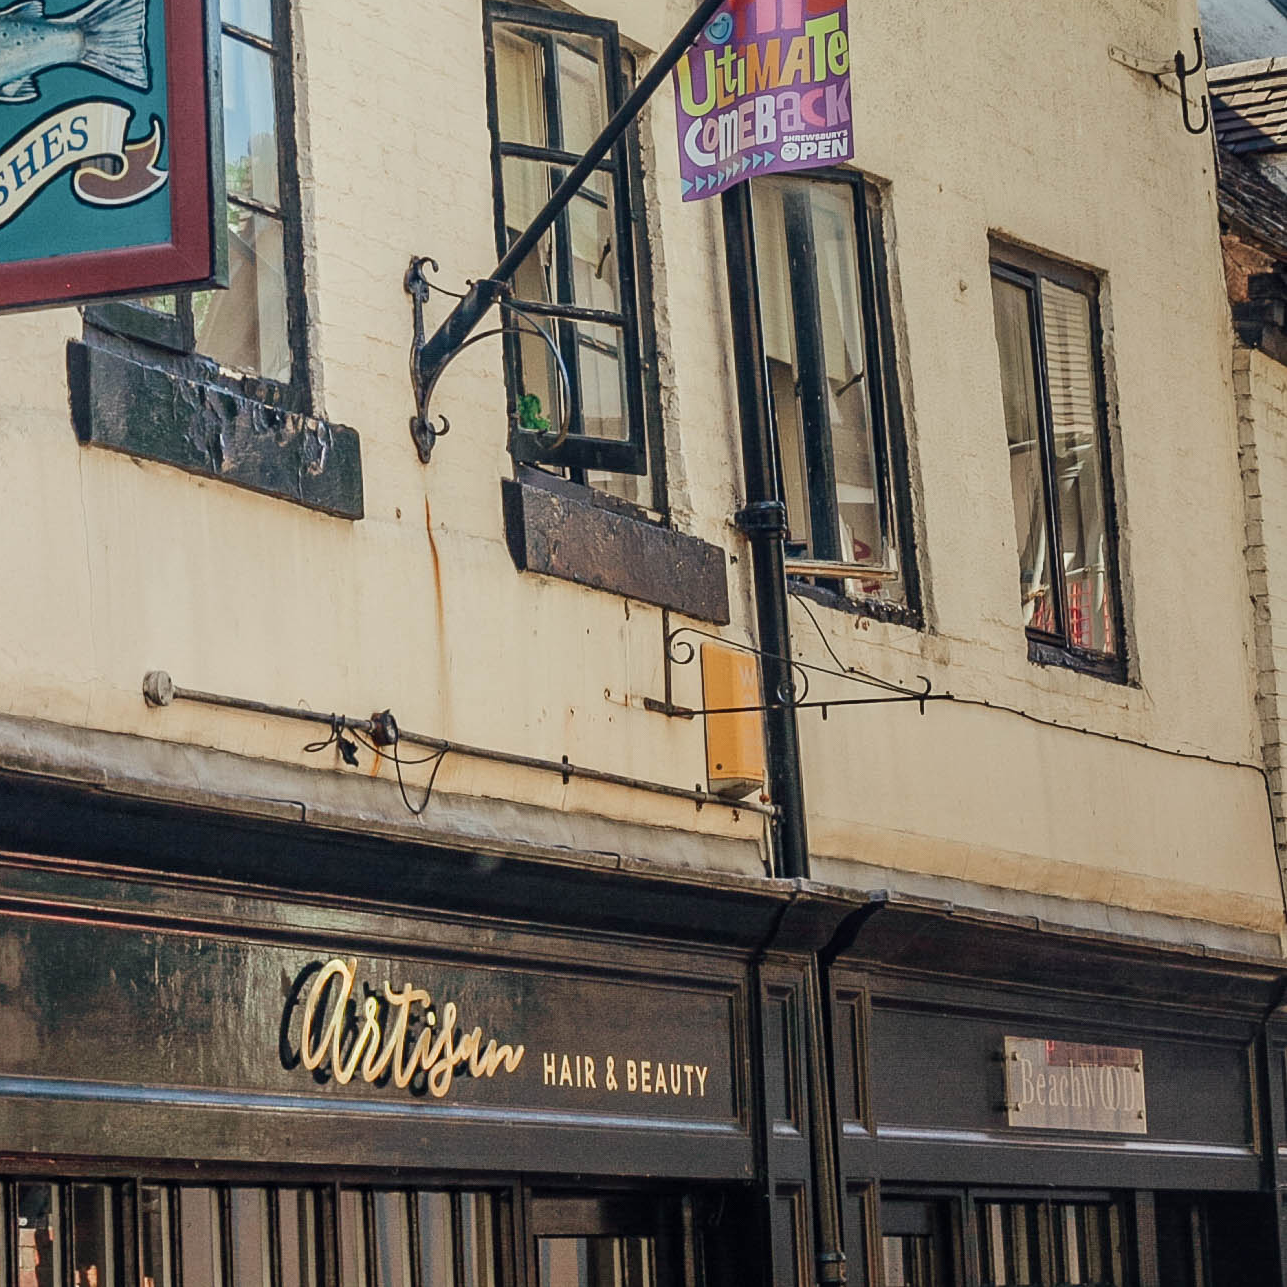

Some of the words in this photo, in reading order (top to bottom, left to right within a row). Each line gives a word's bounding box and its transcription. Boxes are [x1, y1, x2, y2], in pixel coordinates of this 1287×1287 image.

[782, 129, 849, 143] SHREWSBURY'S
[780, 137, 849, 162] OPEN
[542, 1052, 598, 1089] HAIR
[604, 1055, 620, 1092] &
[626, 1059, 709, 1097] BEAUTY
